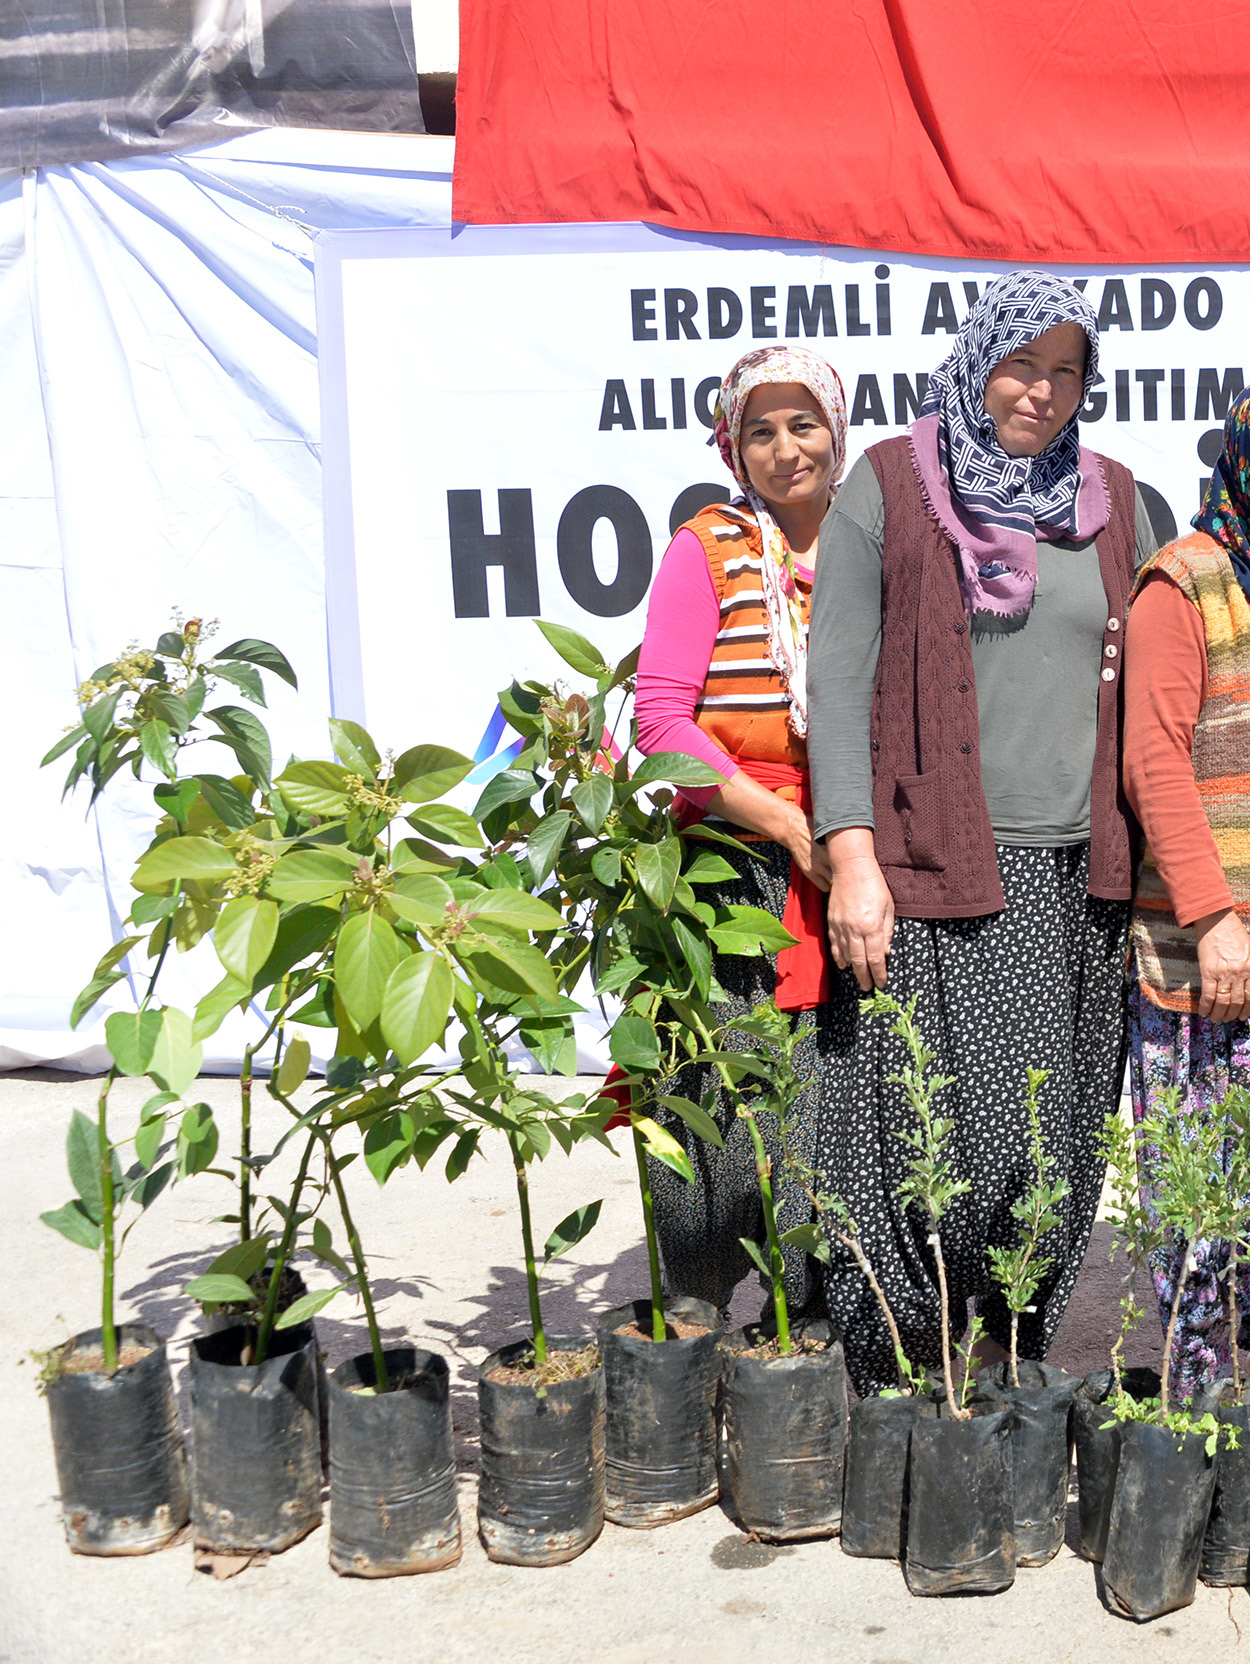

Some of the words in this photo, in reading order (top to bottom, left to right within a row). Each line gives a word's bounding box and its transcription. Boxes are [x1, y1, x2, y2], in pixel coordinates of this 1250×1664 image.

[630, 264, 892, 341] ERDEMLİ
[921, 276, 1223, 335] AADO
[446, 482, 731, 618] HO
